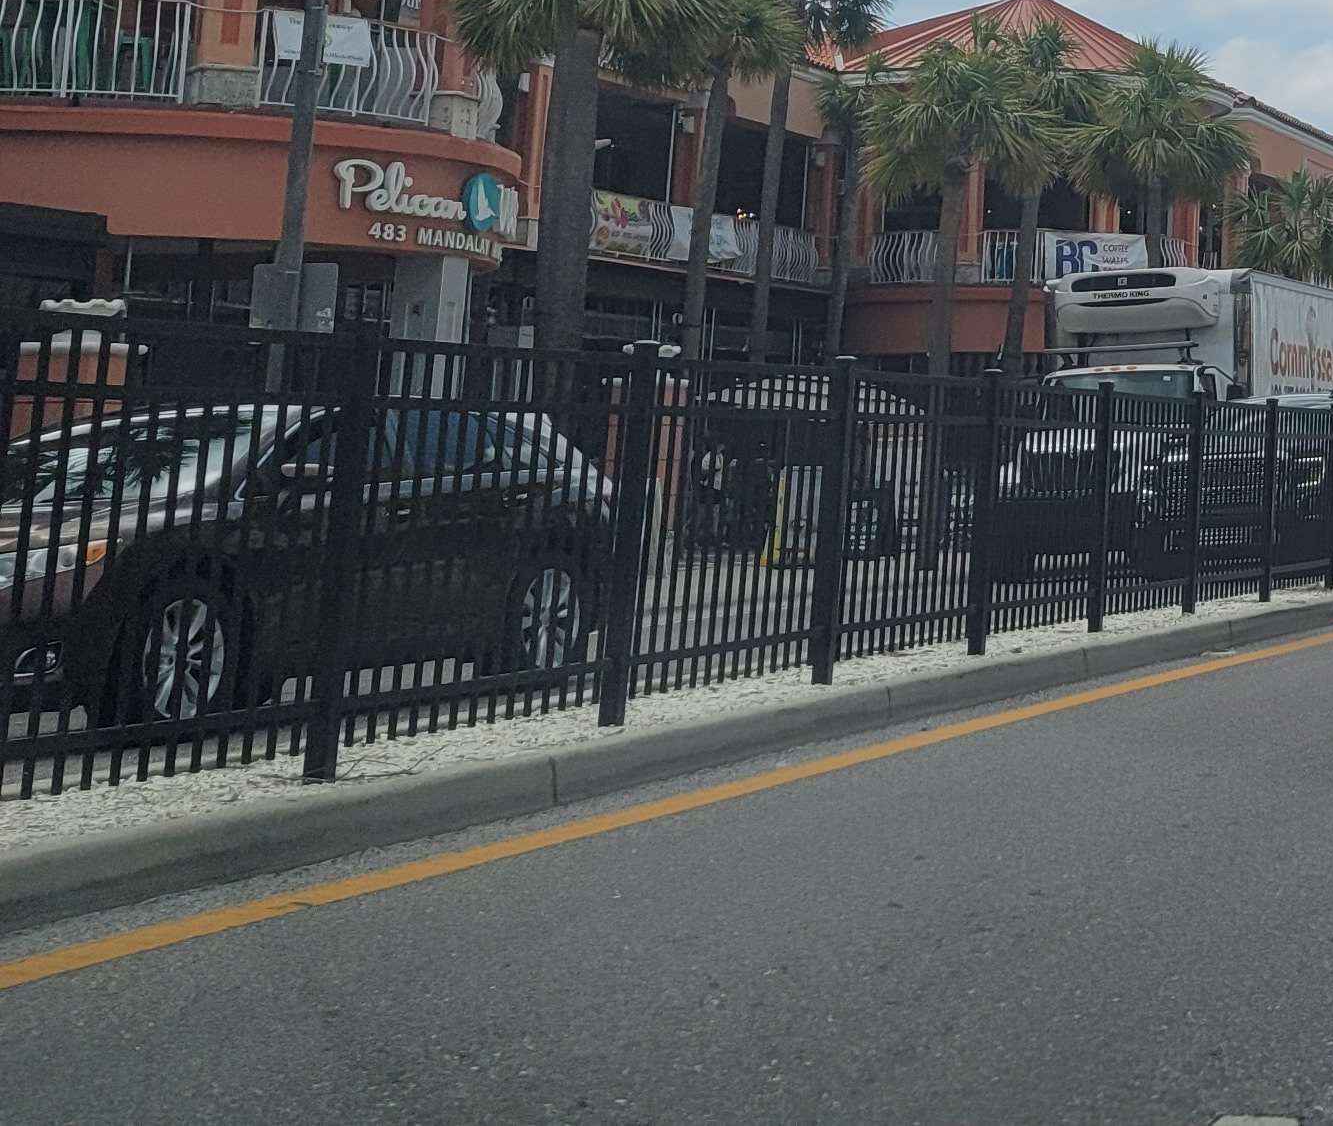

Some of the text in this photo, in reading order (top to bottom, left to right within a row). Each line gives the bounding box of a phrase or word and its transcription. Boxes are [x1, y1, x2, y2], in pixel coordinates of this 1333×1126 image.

[334, 158, 467, 220] Pelican
[368, 222, 407, 241] 483
[417, 226, 490, 255] MANDALAY
[1093, 291, 1128, 299] THERMO
